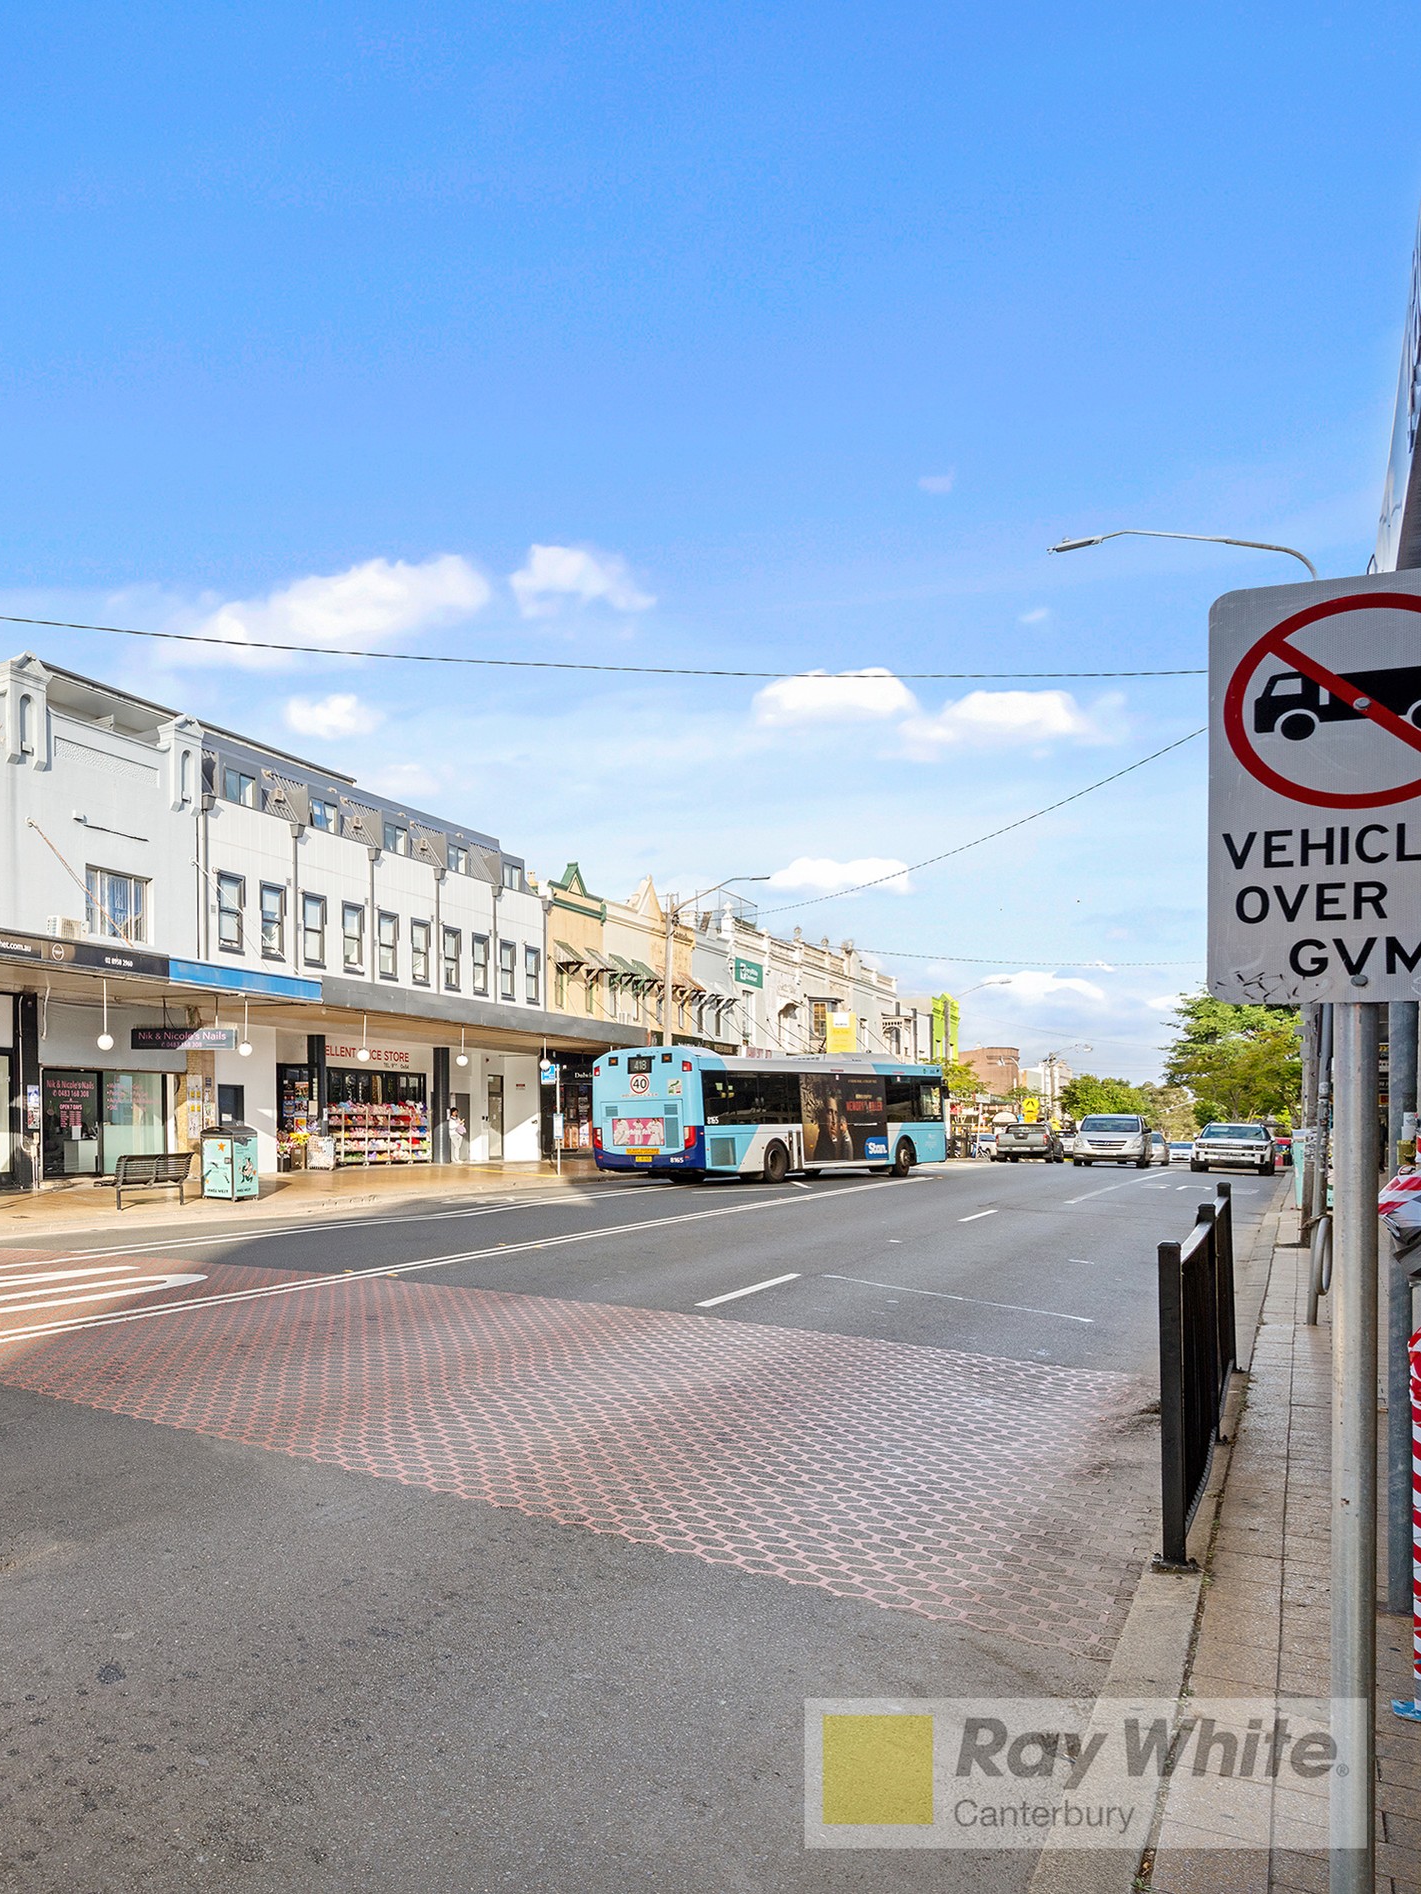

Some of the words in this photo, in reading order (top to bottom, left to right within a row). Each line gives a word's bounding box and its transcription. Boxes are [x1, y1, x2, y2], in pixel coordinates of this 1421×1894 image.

[1235, 881, 1388, 924] OVER
[1289, 935, 1421, 978] GVM
[138, 1032, 153, 1040] Nik
[155, 1032, 161, 1040] &
[164, 1031, 200, 1040] Nicole's
[203, 1031, 226, 1040] Nails
[359, 1048, 382, 1060] ICE
[384, 1051, 409, 1062] STORE
[633, 1060, 647, 1070] 418
[47, 1079, 55, 1088] Nik
[62, 1080, 80, 1089] Nicole's
[81, 1081, 94, 1089] Nails
[633, 1078, 647, 1089] 40
